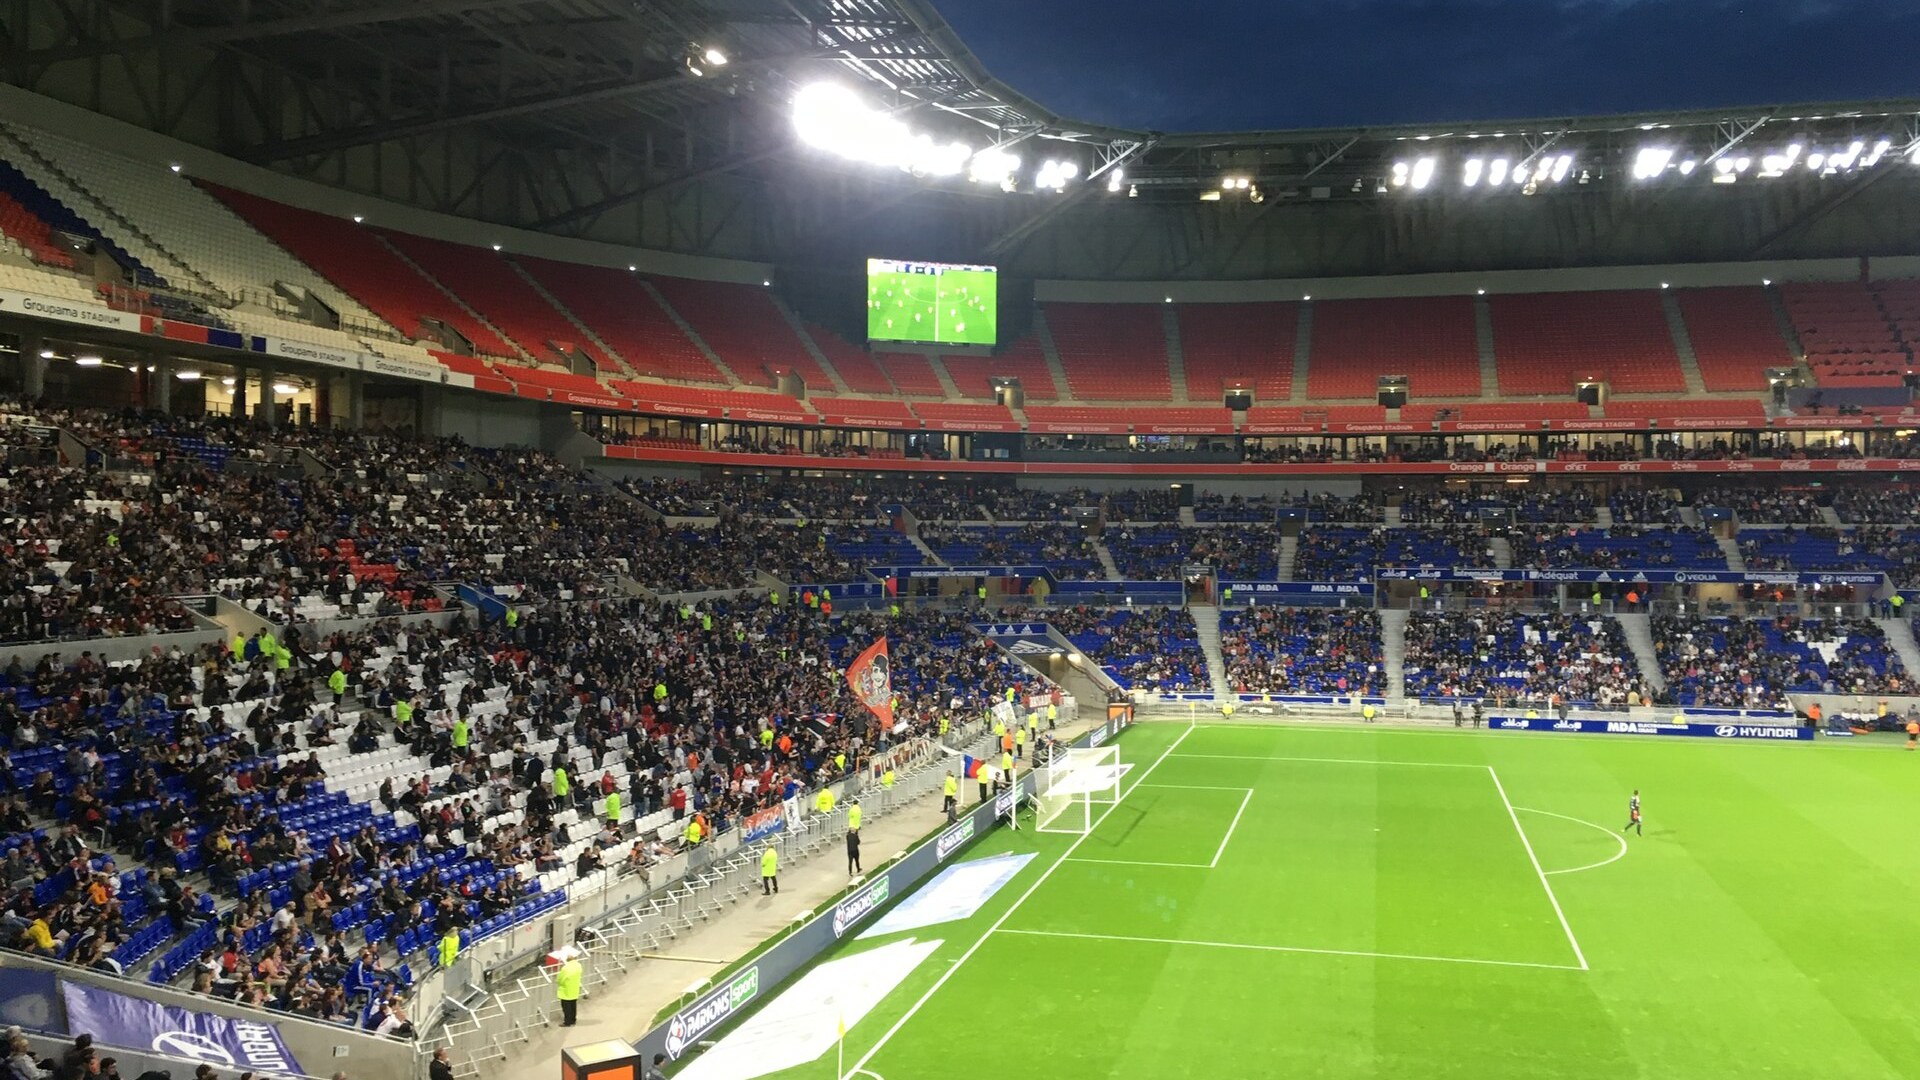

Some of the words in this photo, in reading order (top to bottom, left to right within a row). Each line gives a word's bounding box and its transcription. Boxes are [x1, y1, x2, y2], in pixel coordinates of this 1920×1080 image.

[23, 298, 78, 318] Groupama
[81, 311, 120, 324] STADIUM
[280, 342, 317, 359] Groupama
[319, 352, 346, 363] STADIUM
[375, 360, 407, 374] Groupama
[568, 392, 596, 406] Groupama
[597, 398, 618, 407] STADIUM
[654, 403, 685, 414] Groupama
[686, 408, 708, 416] STADIUM
[746, 411, 778, 421] Groupama
[1786, 416, 1828, 426] Groupama
[844, 417, 877, 427] Groupama
[943, 420, 976, 430] Groupama
[1457, 422, 1494, 430] Groupama
[1564, 420, 1602, 429] Groupama
[1674, 418, 1714, 428] Groupama
[1048, 424, 1082, 433] Groupama
[1152, 425, 1188, 434] Groupama
[1249, 425, 1285, 434] Groupama
[1346, 423, 1383, 432] Groupama
[1450, 463, 1484, 472] Orange
[1500, 463, 1535, 471] Orange
[1538, 571, 1578, 580] Adéquat
[1607, 722, 1638, 732] MDA
[1740, 726, 1798, 738] HYUNDAI
[846, 892, 872, 923] PARIONS
[872, 880, 888, 902] sport
[687, 991, 730, 1037] PARIONS
[732, 972, 756, 1002] sport
